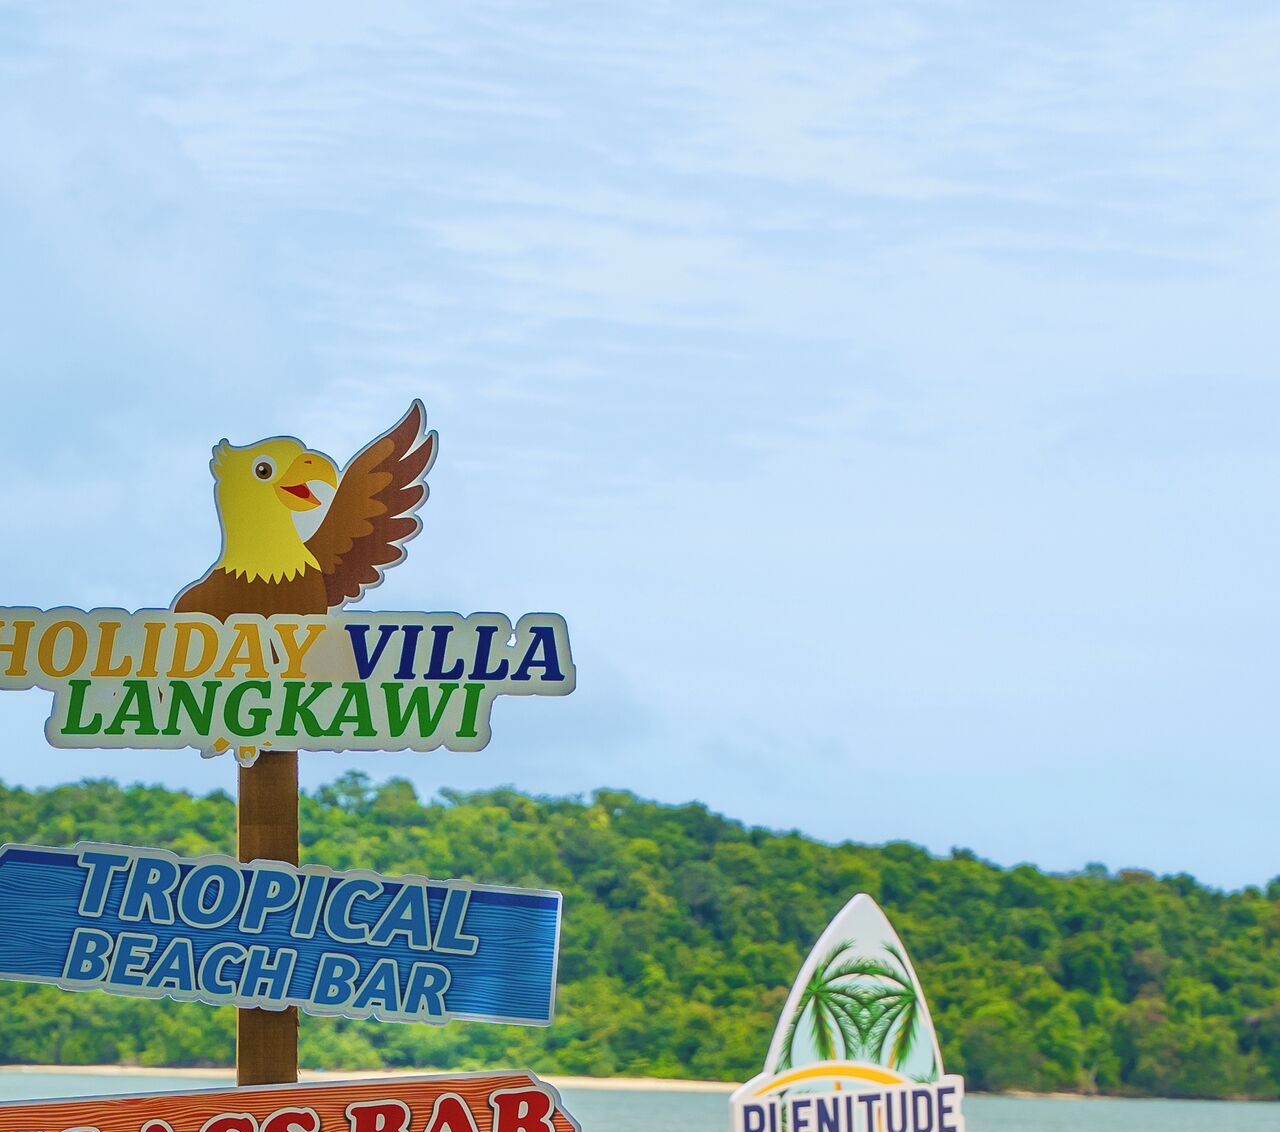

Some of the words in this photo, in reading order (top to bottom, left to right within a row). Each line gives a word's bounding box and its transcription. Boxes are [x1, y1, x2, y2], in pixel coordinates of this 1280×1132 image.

[344, 625, 566, 682] VILLA
[60, 680, 485, 738] LANGKAWI
[77, 851, 479, 955] TROPICAL
[66, 928, 296, 1000] BEACH
[310, 957, 451, 1017] BAR
